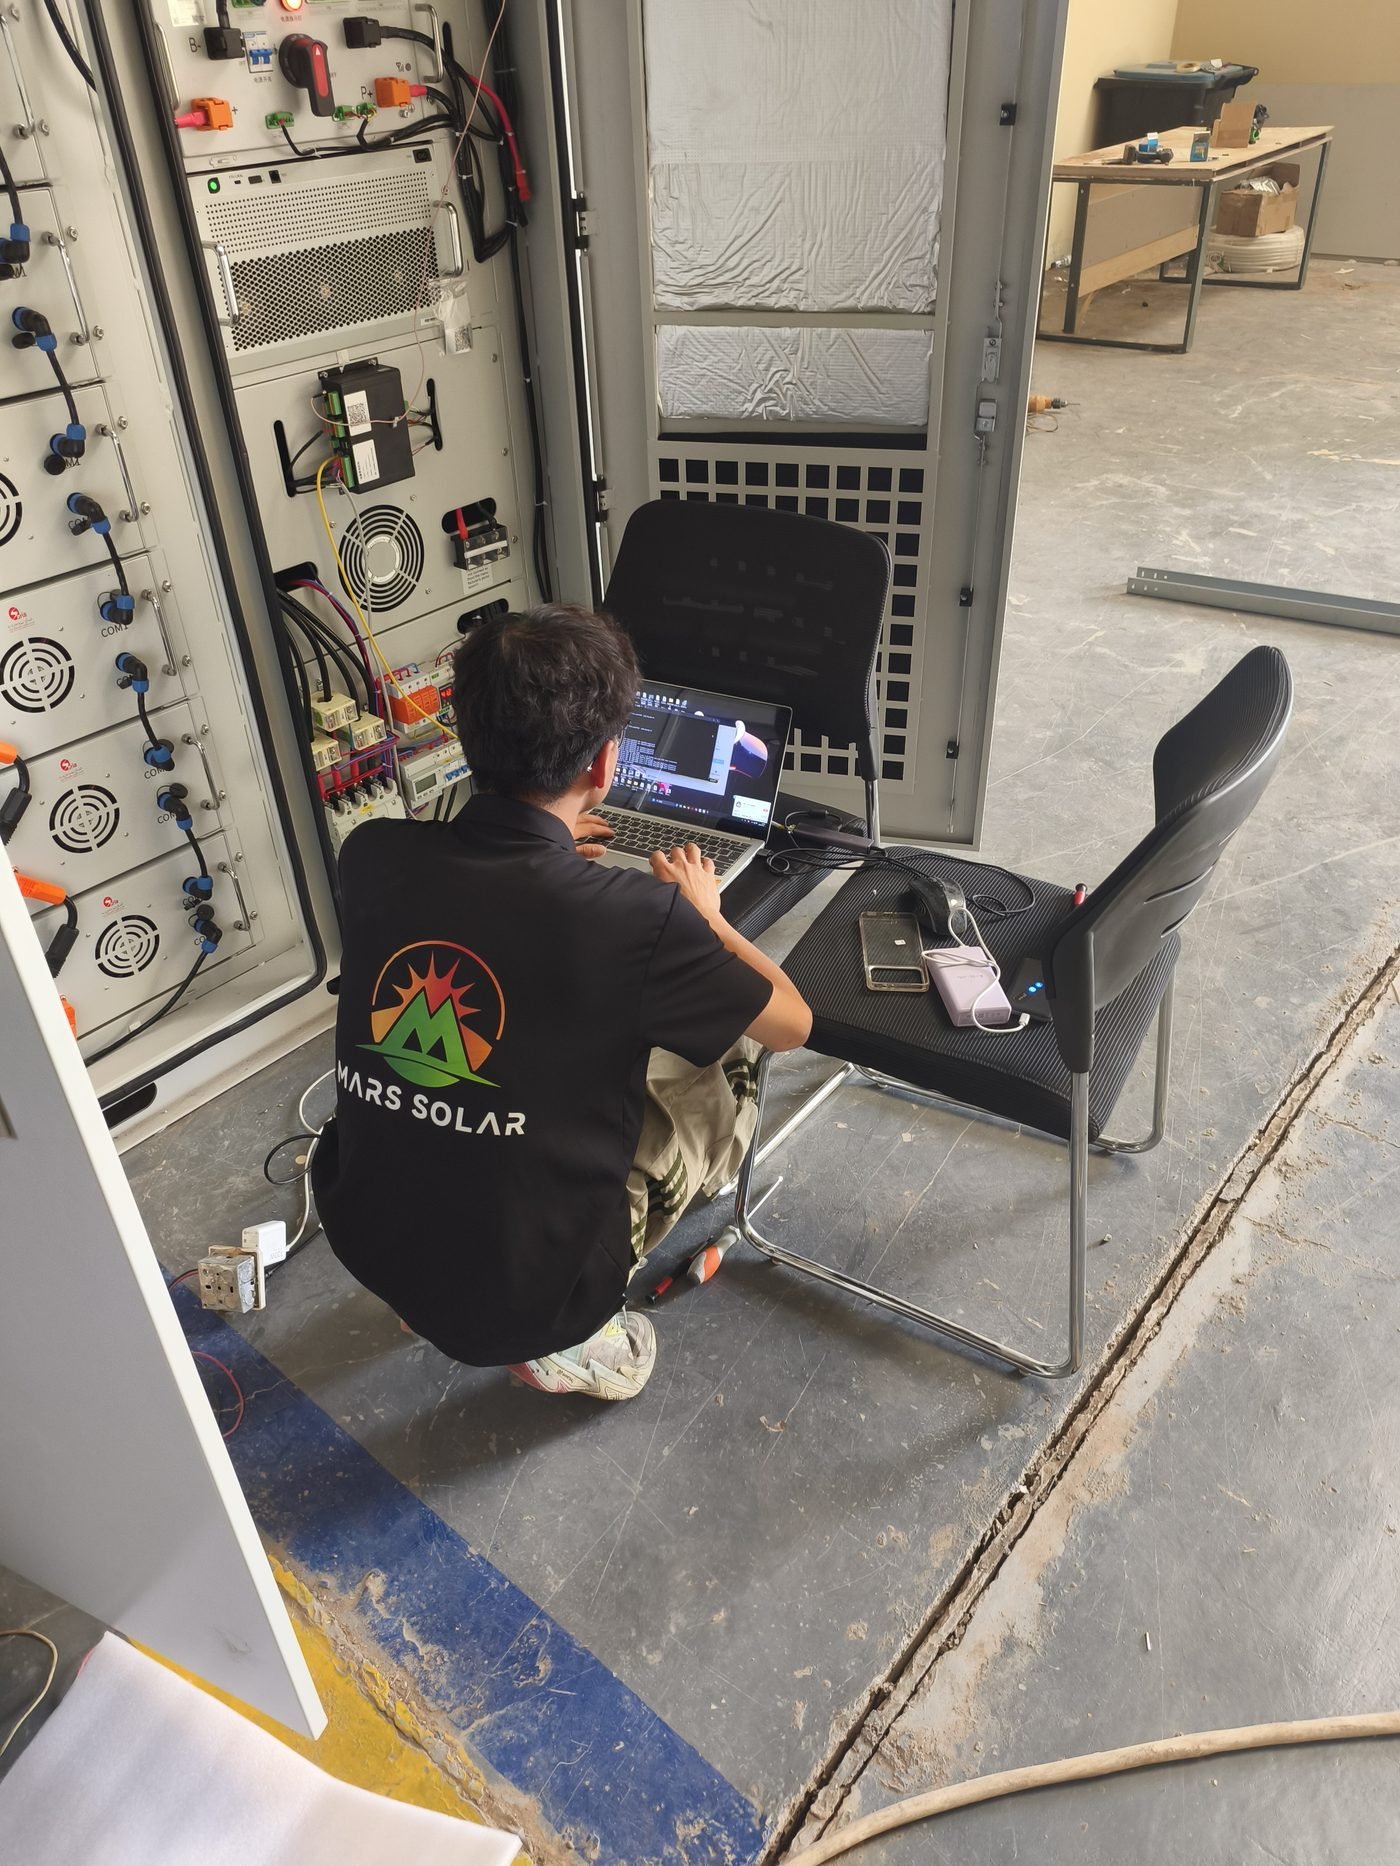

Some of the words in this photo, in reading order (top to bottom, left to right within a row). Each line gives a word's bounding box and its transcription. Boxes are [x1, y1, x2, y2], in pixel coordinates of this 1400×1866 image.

[360, 85, 374, 100] P+
[337, 1059, 402, 1111] MARS
[411, 1093, 526, 1136] SOLAR
